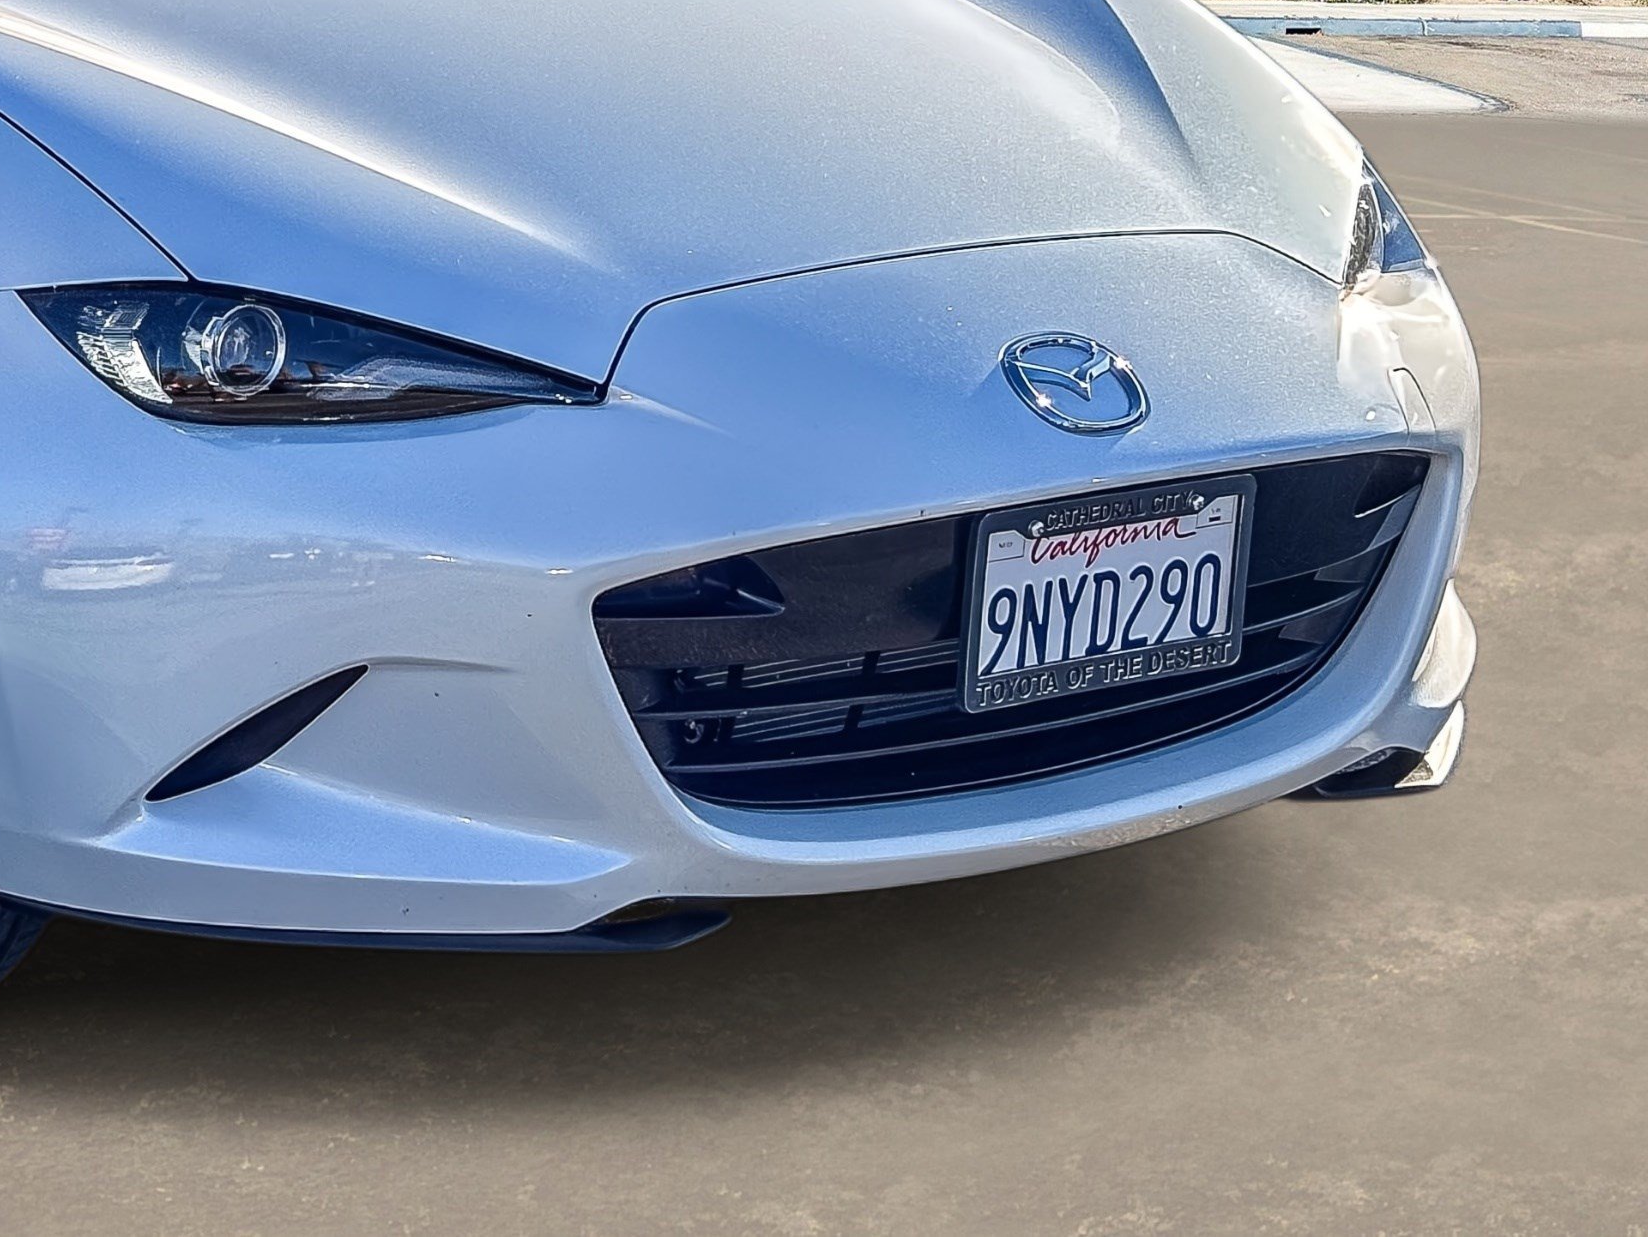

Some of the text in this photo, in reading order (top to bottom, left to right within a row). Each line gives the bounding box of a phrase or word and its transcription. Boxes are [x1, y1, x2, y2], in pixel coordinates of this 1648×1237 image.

[1046, 490, 1193, 531] CATHEDRAL CITY
[1031, 517, 1196, 568] California
[979, 553, 1222, 676] 9NYD290
[976, 641, 1232, 706] TOYOTA OF THE DESERT
